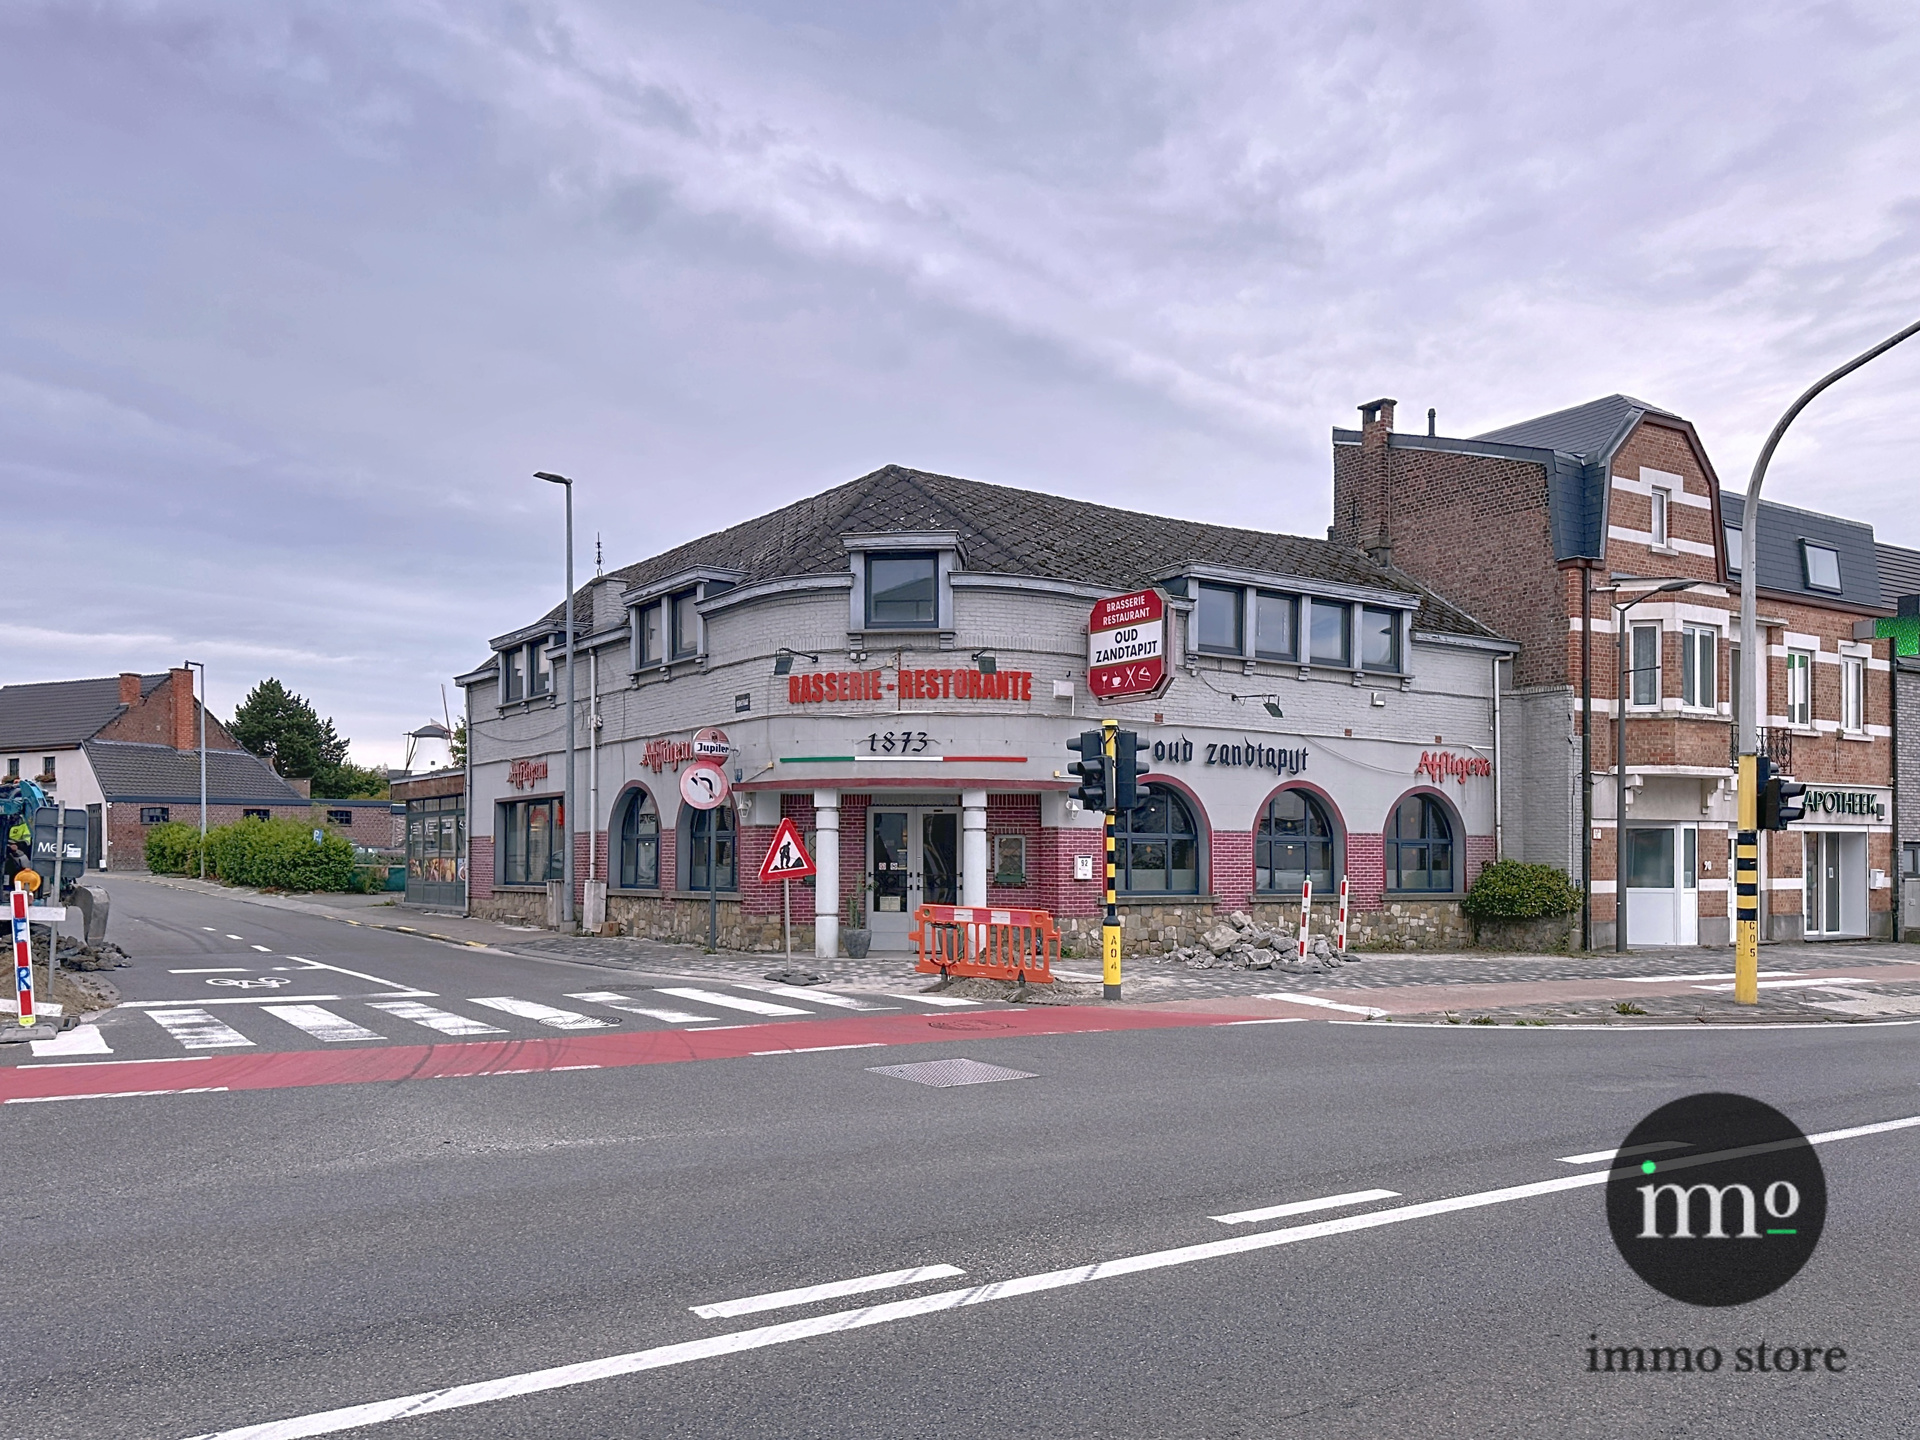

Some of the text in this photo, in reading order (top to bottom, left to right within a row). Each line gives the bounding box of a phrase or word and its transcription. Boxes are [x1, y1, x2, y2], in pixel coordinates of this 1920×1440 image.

[1106, 595, 1146, 613] BRASSERIE
[1103, 607, 1151, 626] RESTAURANT
[1114, 628, 1139, 644] OUD
[1096, 640, 1158, 663] ZANDTAPIJT
[900, 668, 1033, 701] RESTORANTE
[697, 742, 730, 755] Jupiler
[868, 731, 928, 753] 1873
[1153, 733, 1194, 763] oud
[1414, 750, 1491, 785] Affligem
[1802, 790, 1878, 815] APOTHEEK
[1080, 859, 1089, 867] 92
